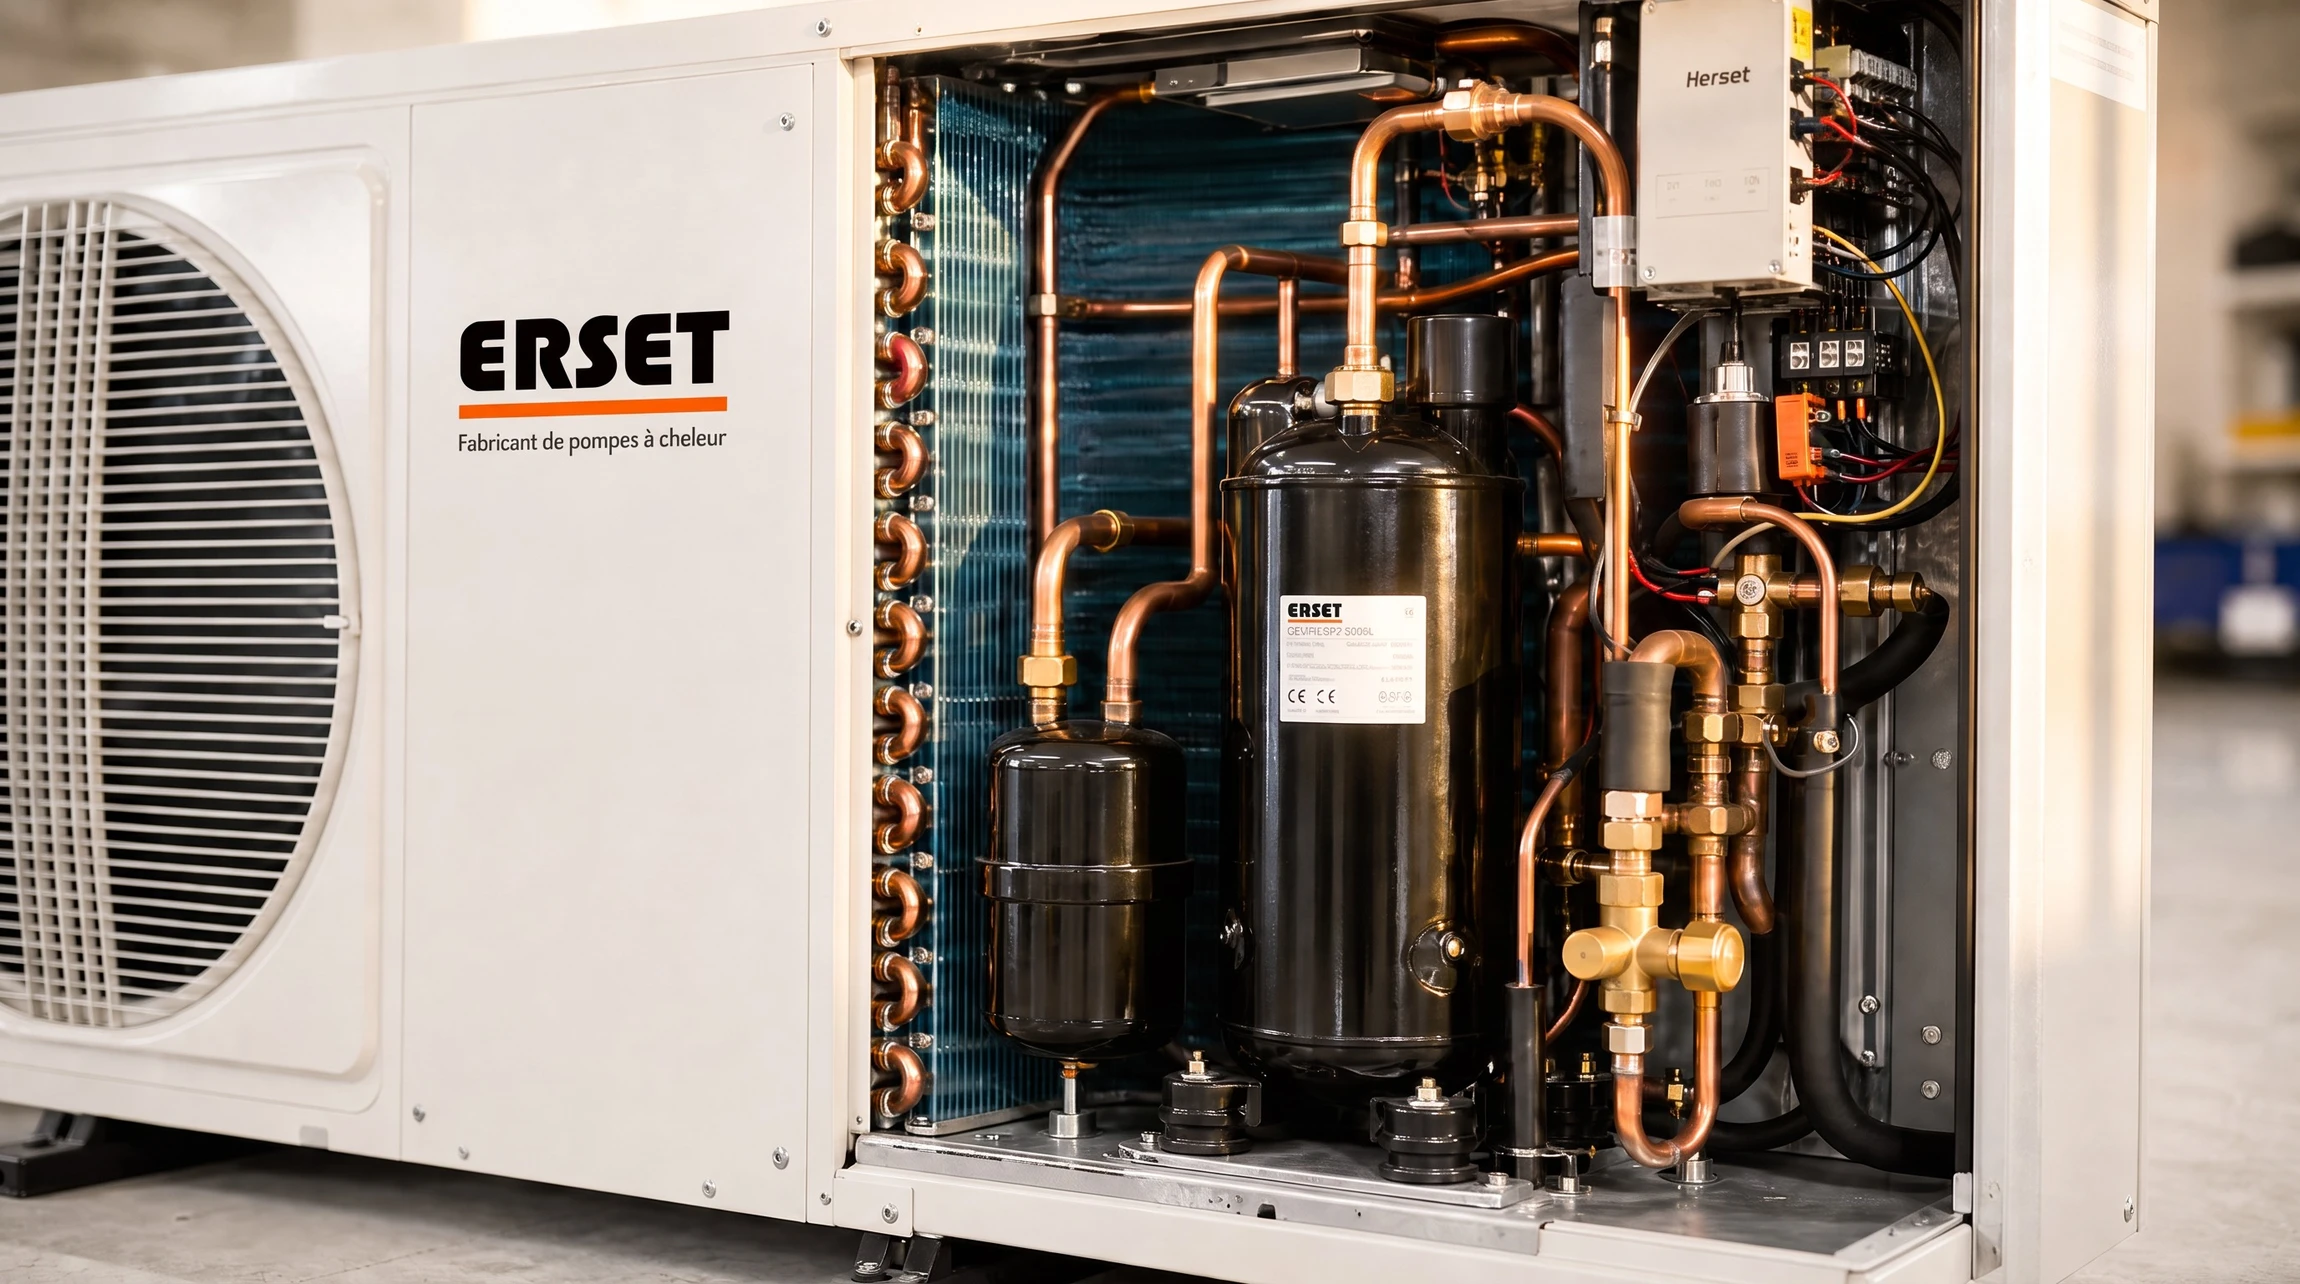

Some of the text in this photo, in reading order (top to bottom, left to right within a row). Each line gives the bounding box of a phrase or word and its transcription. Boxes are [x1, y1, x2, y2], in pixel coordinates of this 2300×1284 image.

[1687, 66, 1750, 88] Herset
[460, 310, 730, 391] ERSET
[459, 427, 727, 456] Fabricant de pompes à cheleur
[1288, 603, 1342, 617] ERSET
[1288, 689, 1306, 704] CE
